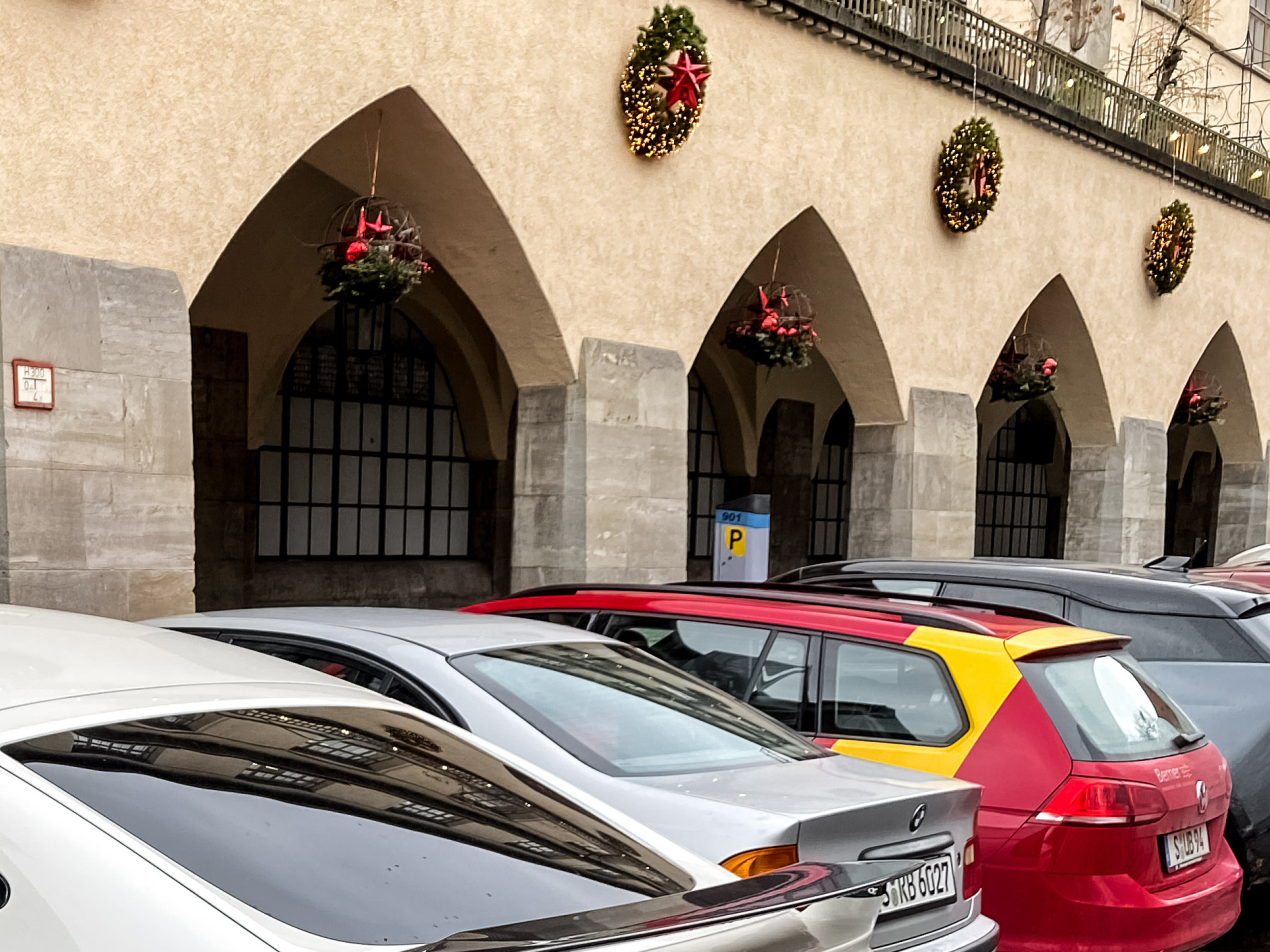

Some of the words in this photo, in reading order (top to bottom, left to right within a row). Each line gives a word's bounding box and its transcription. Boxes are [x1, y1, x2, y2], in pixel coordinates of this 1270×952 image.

[722, 511, 742, 522] 901
[730, 528, 743, 550] P
[1174, 835, 1180, 860] S
[919, 861, 949, 897] 6027
